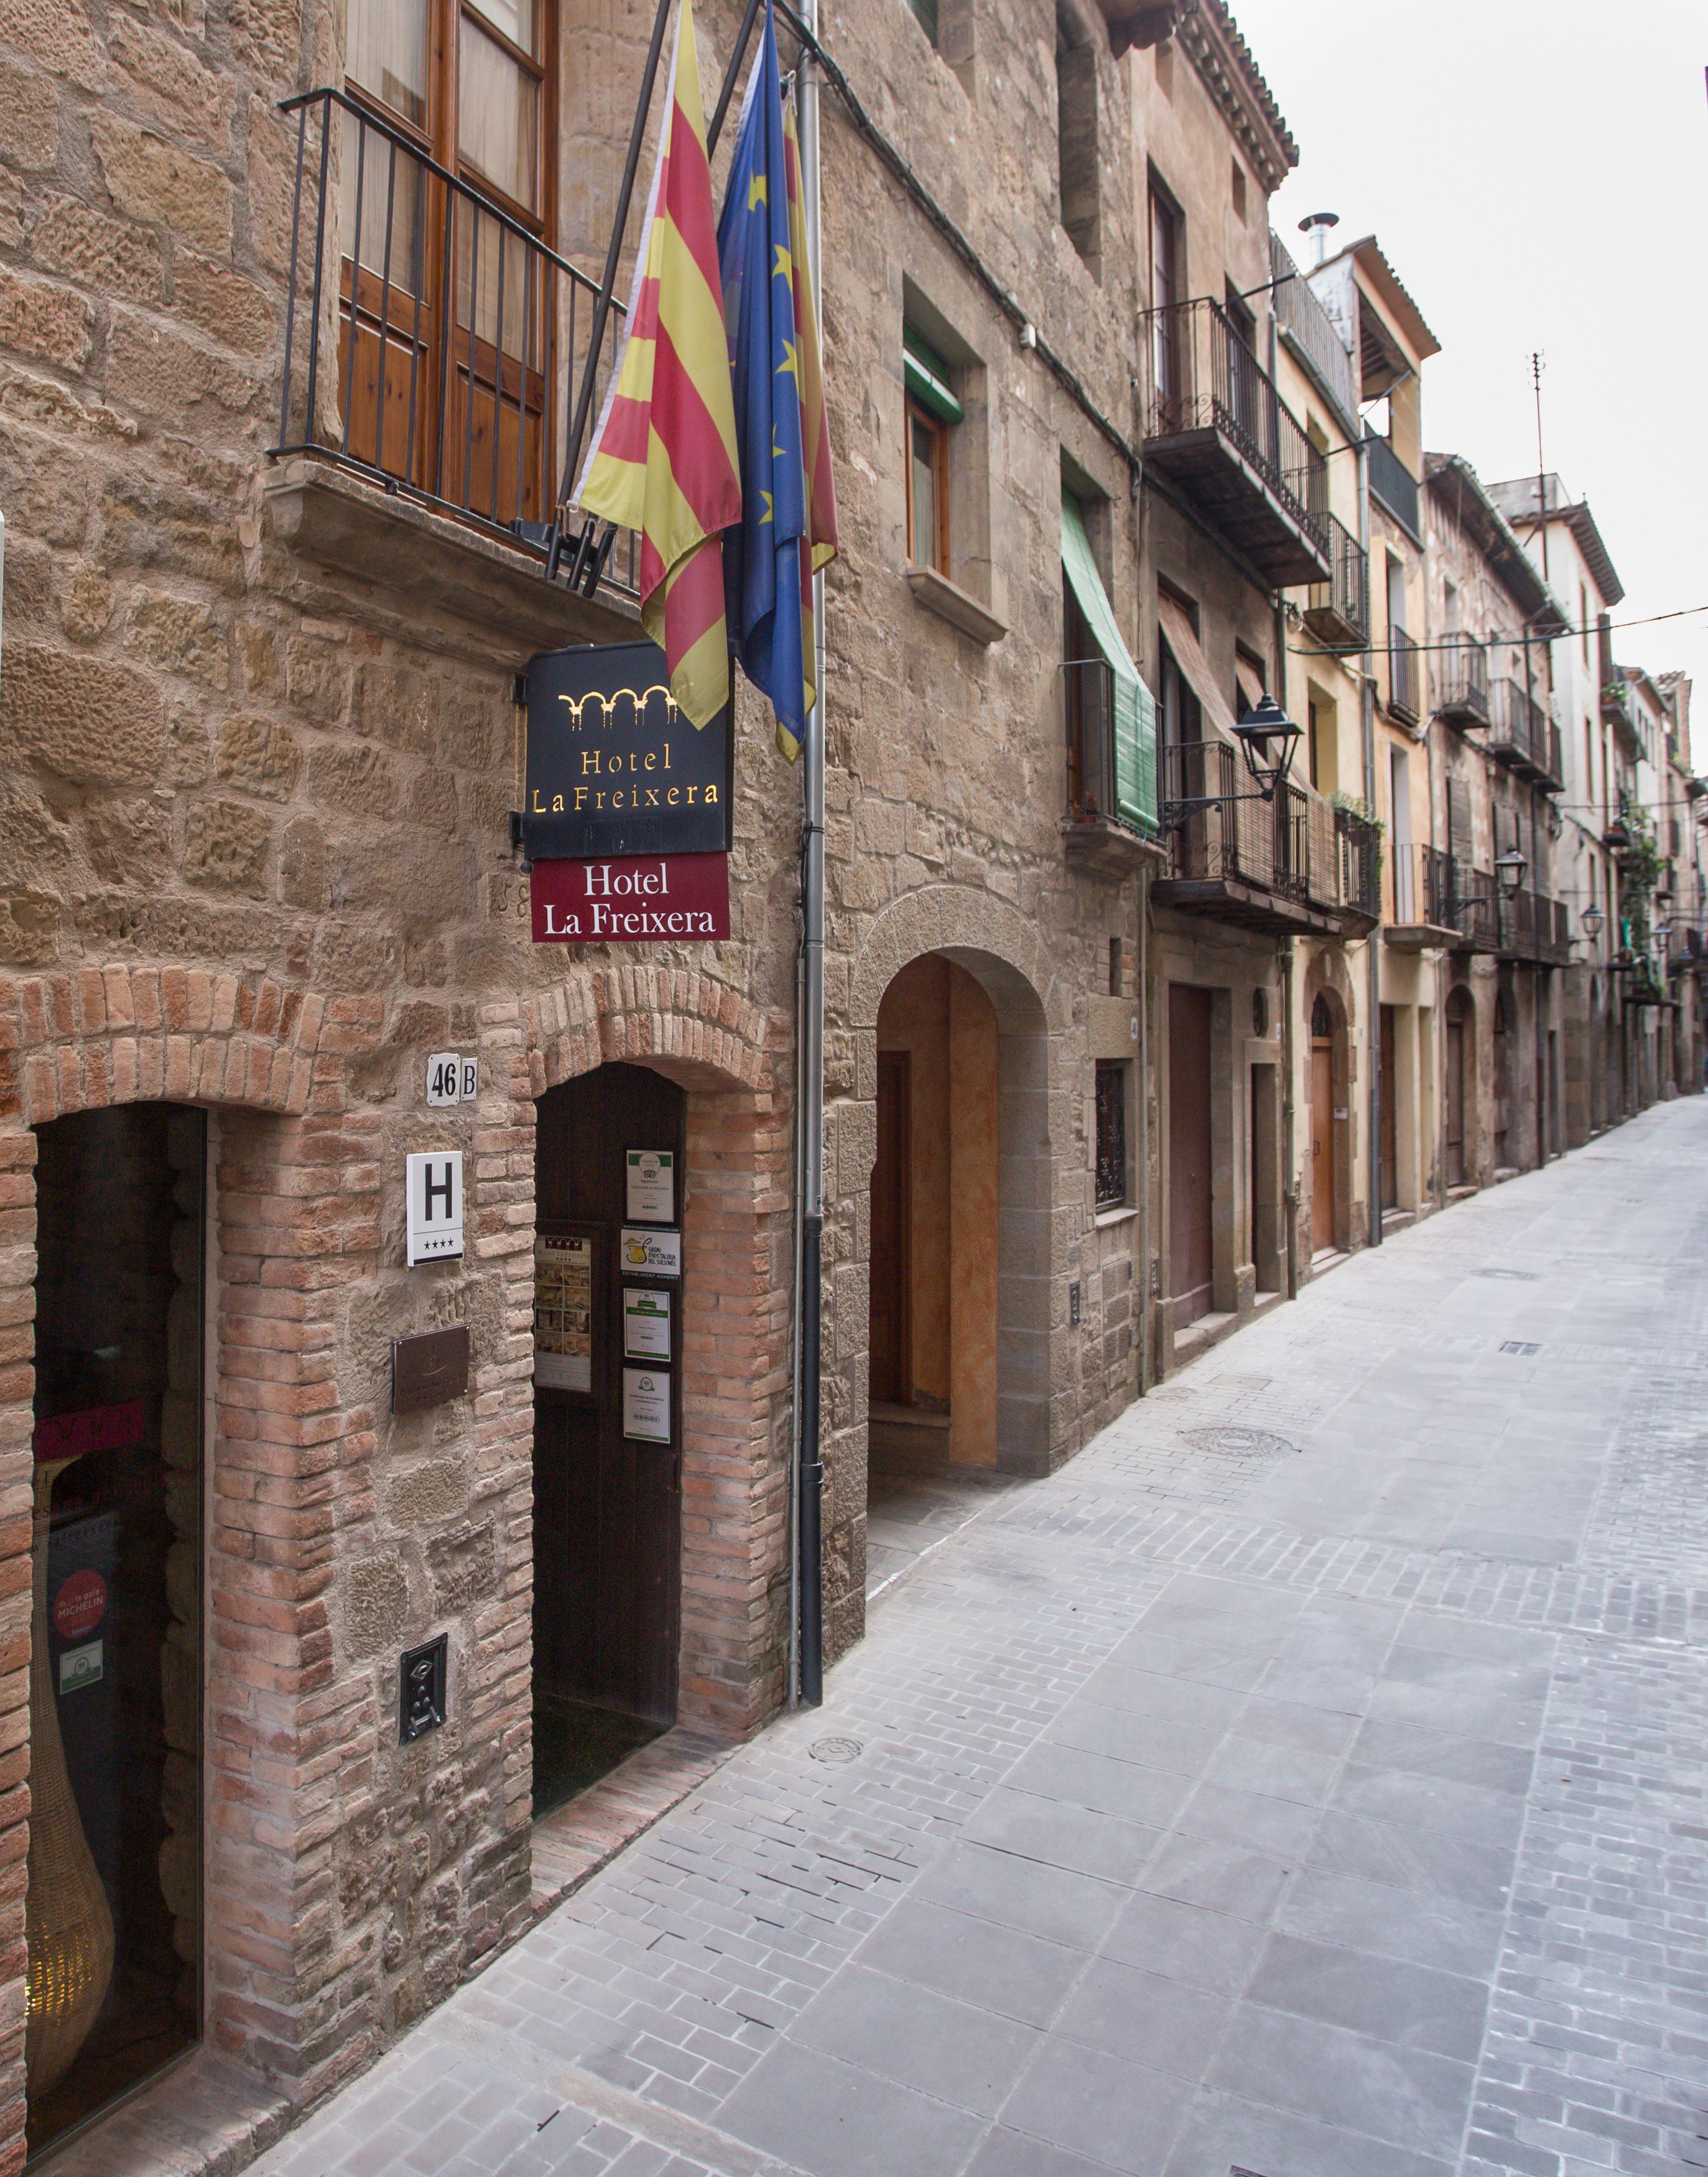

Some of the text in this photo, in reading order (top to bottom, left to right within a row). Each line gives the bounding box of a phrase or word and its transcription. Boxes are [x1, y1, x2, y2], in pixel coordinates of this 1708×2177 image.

[581, 744, 671, 775] Hotel
[574, 784, 718, 810] Freixera
[583, 863, 669, 896] Hotel
[544, 902, 716, 934] La Freixera
[432, 1063, 456, 1097] 46
[463, 1065, 475, 1094] B
[425, 1162, 452, 1221] H
[58, 1595, 103, 1620] MICHELIN
